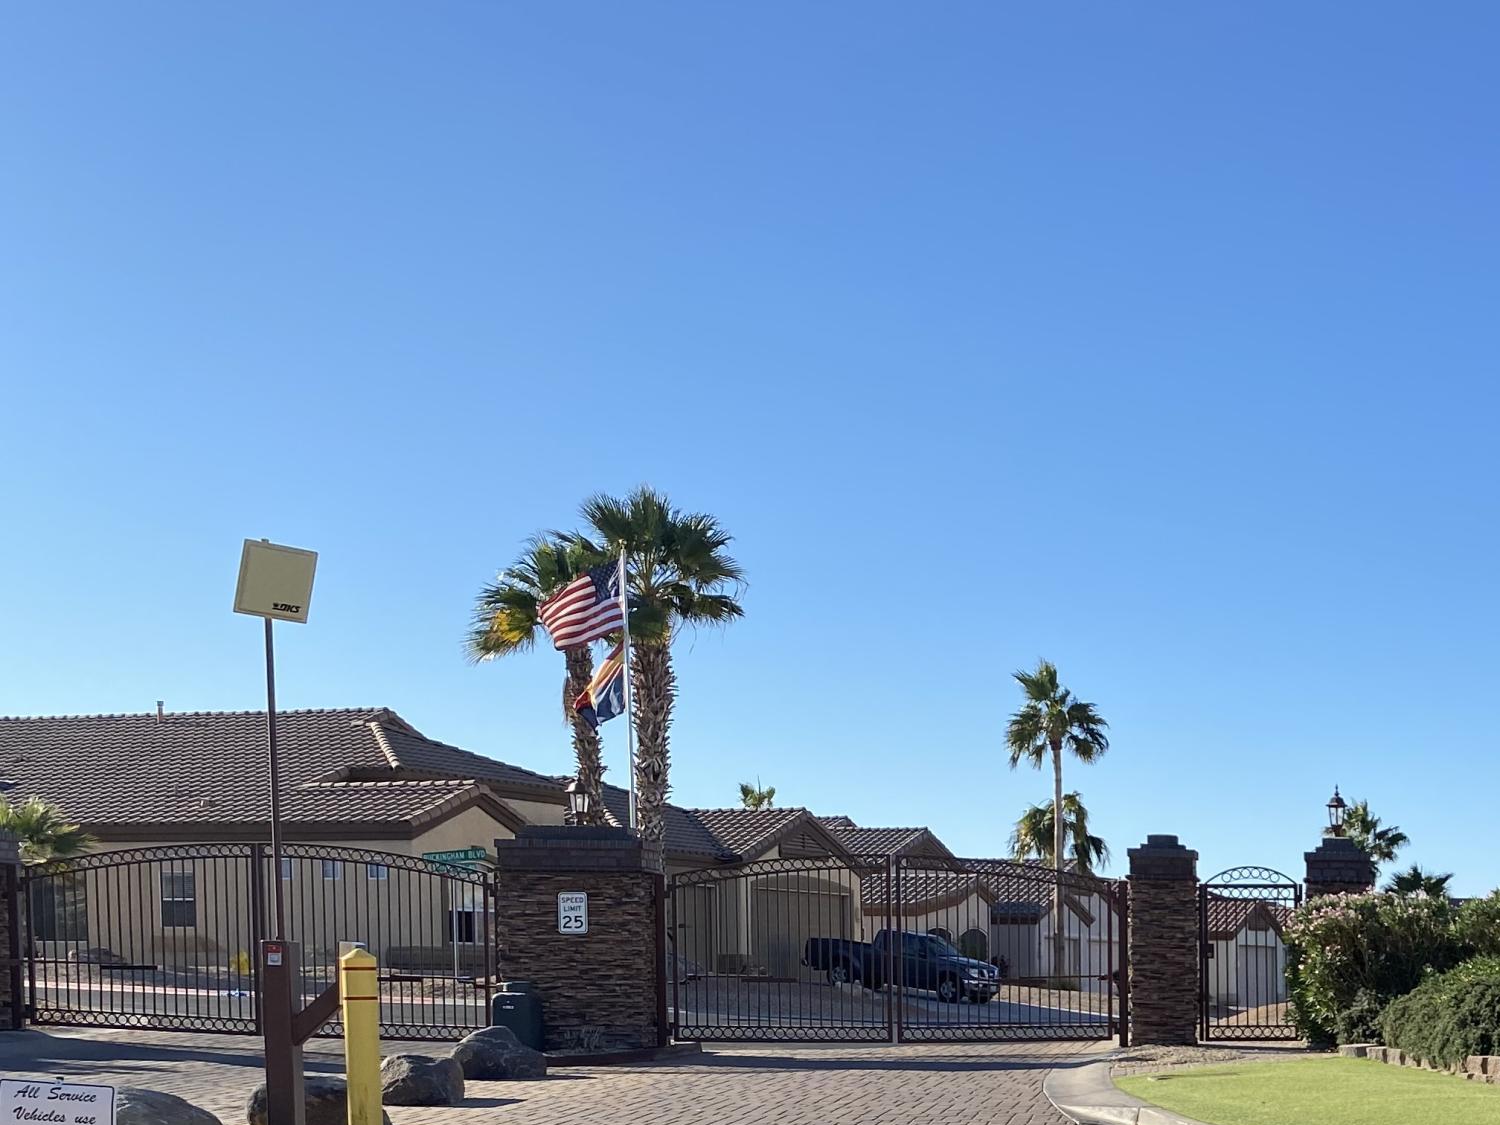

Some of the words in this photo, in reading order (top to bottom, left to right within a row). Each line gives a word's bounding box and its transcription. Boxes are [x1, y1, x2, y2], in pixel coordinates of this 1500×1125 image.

[468, 849, 486, 859] BLVD
[562, 915, 584, 929] 25
[14, 1085, 40, 1098] All
[47, 1087, 97, 1102] Service
[13, 1106, 66, 1122] Vehicles
[74, 1115, 96, 1124] use
